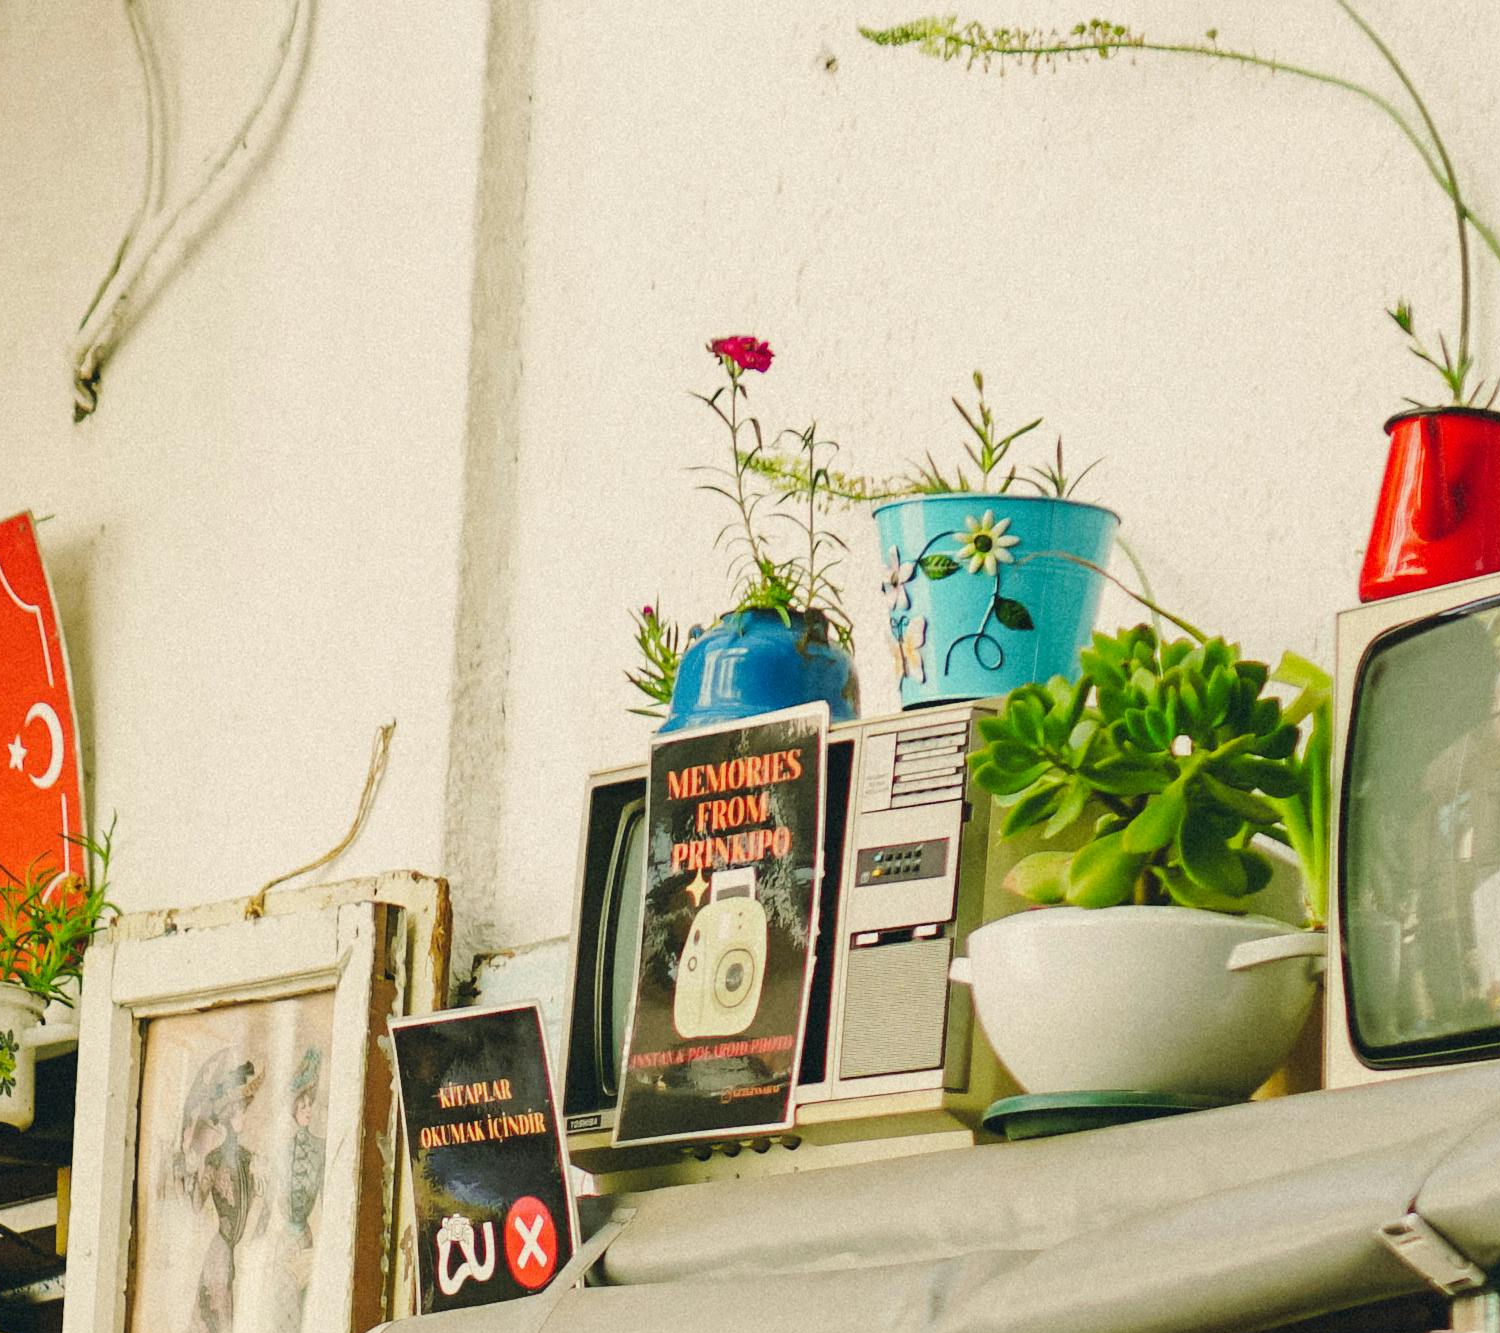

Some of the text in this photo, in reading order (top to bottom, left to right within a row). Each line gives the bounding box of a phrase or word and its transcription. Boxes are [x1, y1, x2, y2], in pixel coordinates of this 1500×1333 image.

[666, 749, 803, 800] MEMORIES
[695, 791, 771, 834] FROM
[671, 826, 792, 874] PRINKIPO
[438, 1078, 513, 1109] KİTAPLAR
[420, 1108, 547, 1149] OKUMAK İÇİNDİR
